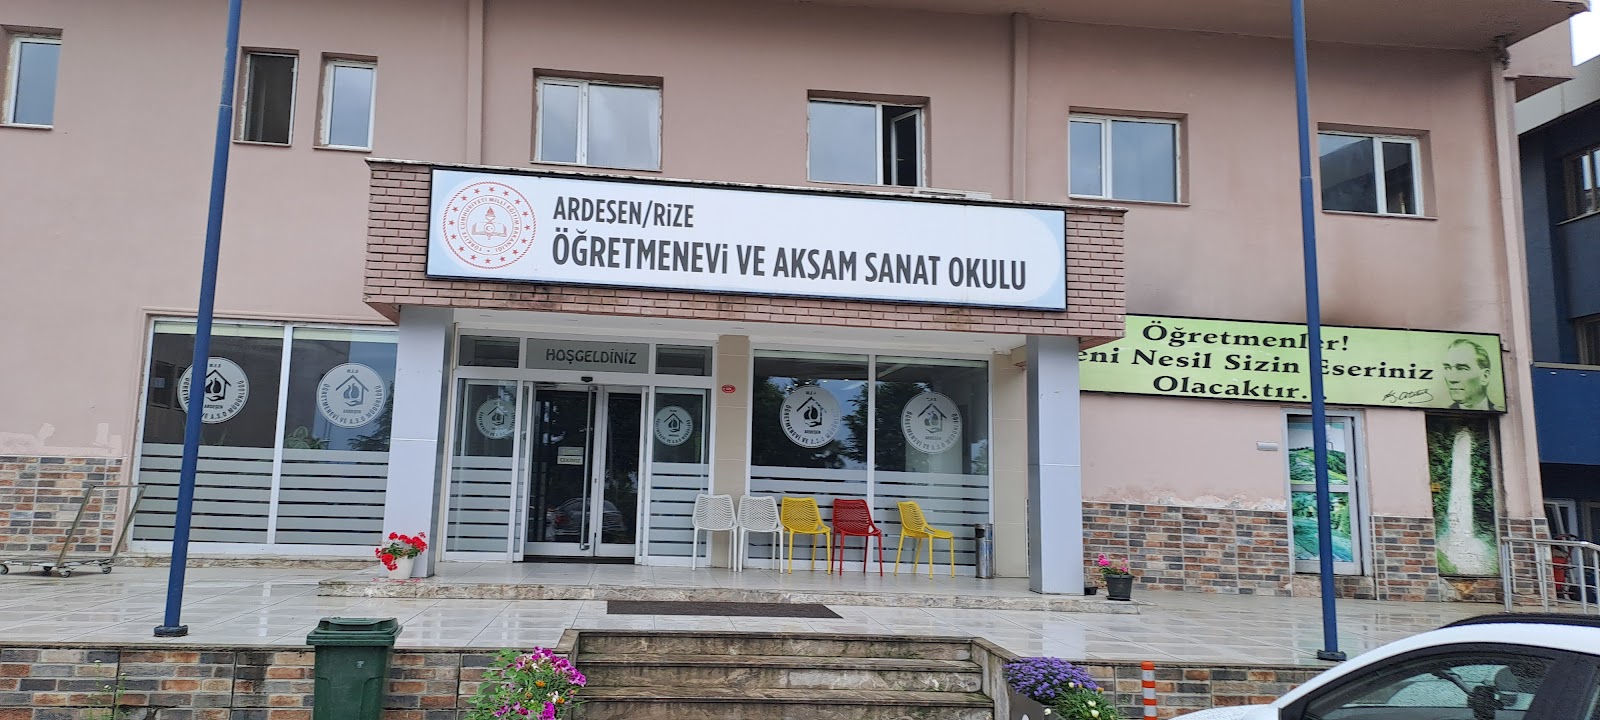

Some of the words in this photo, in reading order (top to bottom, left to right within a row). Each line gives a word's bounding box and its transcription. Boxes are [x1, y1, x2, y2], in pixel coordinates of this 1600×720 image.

[736, 244, 766, 276] VE
[773, 246, 857, 281] AKŞAM
[865, 252, 941, 286] SANAT
[949, 256, 1026, 291] OKULU
[546, 348, 637, 365] HOŞGELDİNİZ
[1077, 346, 1120, 364] eni
[1131, 349, 1212, 369] Nesil
[1225, 353, 1300, 374] Sizin
